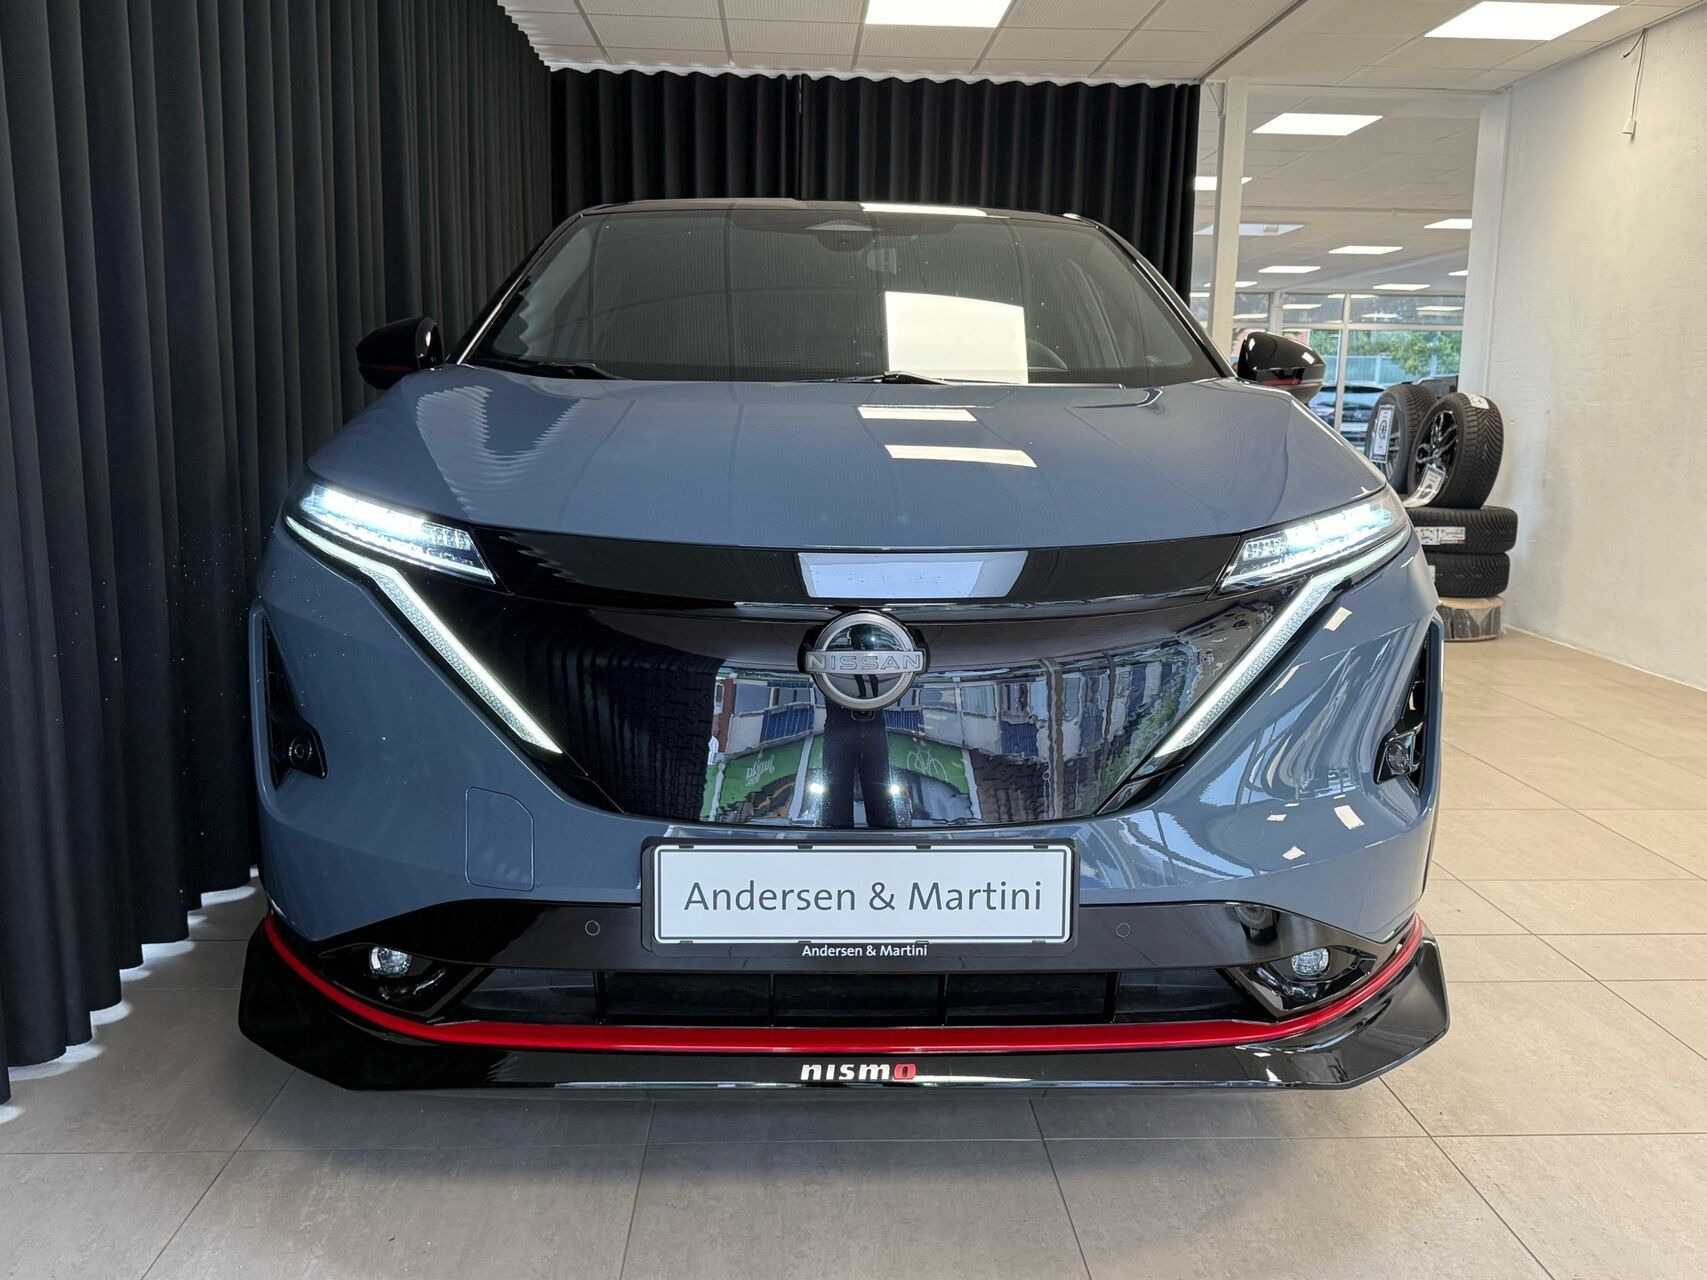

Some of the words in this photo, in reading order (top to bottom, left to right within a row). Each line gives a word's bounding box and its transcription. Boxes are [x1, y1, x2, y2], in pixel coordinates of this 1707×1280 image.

[807, 654, 920, 670] NISSAN
[684, 880, 855, 911] Andersen
[868, 882, 896, 911] &
[908, 881, 1042, 911] Martini
[801, 944, 863, 957] Andersen
[866, 945, 876, 957] &
[879, 944, 928, 957] Martini
[801, 1062, 917, 1081] nismo
